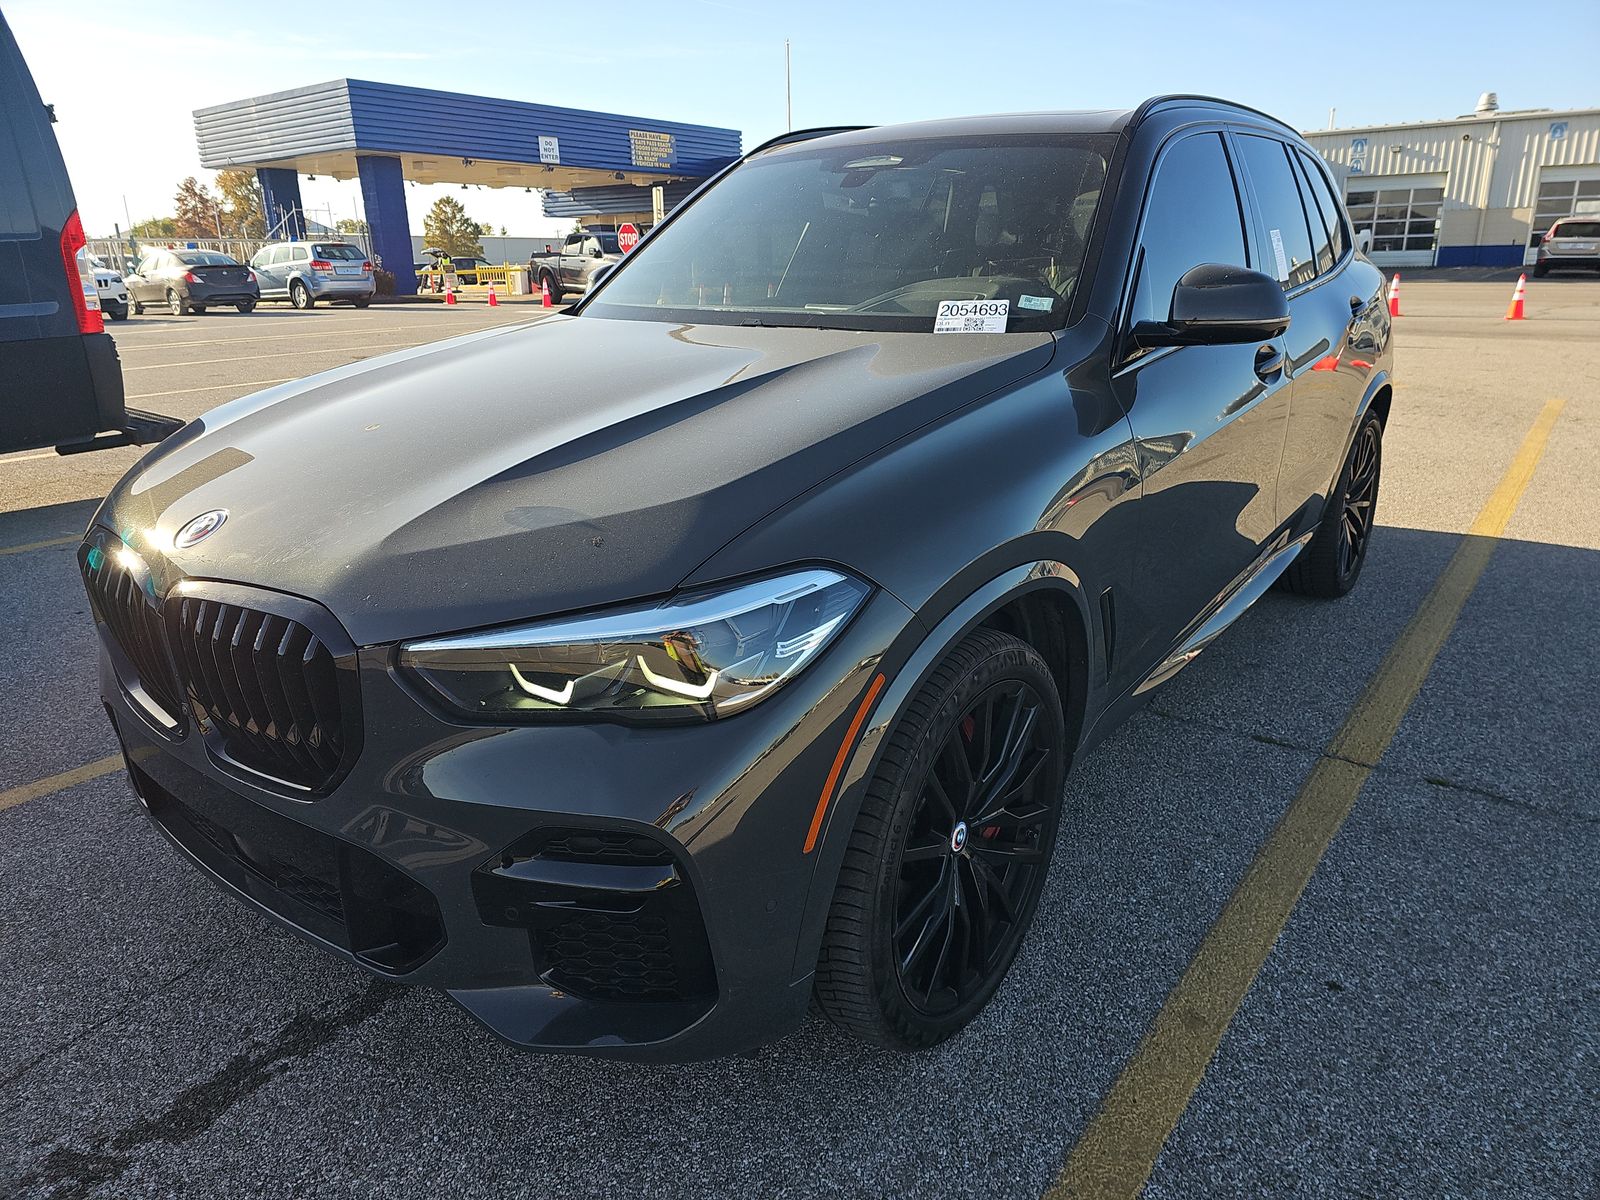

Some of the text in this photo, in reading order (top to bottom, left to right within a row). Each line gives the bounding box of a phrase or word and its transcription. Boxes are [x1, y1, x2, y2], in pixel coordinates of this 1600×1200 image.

[541, 153, 559, 161] ENTER
[619, 232, 637, 246] STOP
[940, 303, 1008, 317] 2054693
